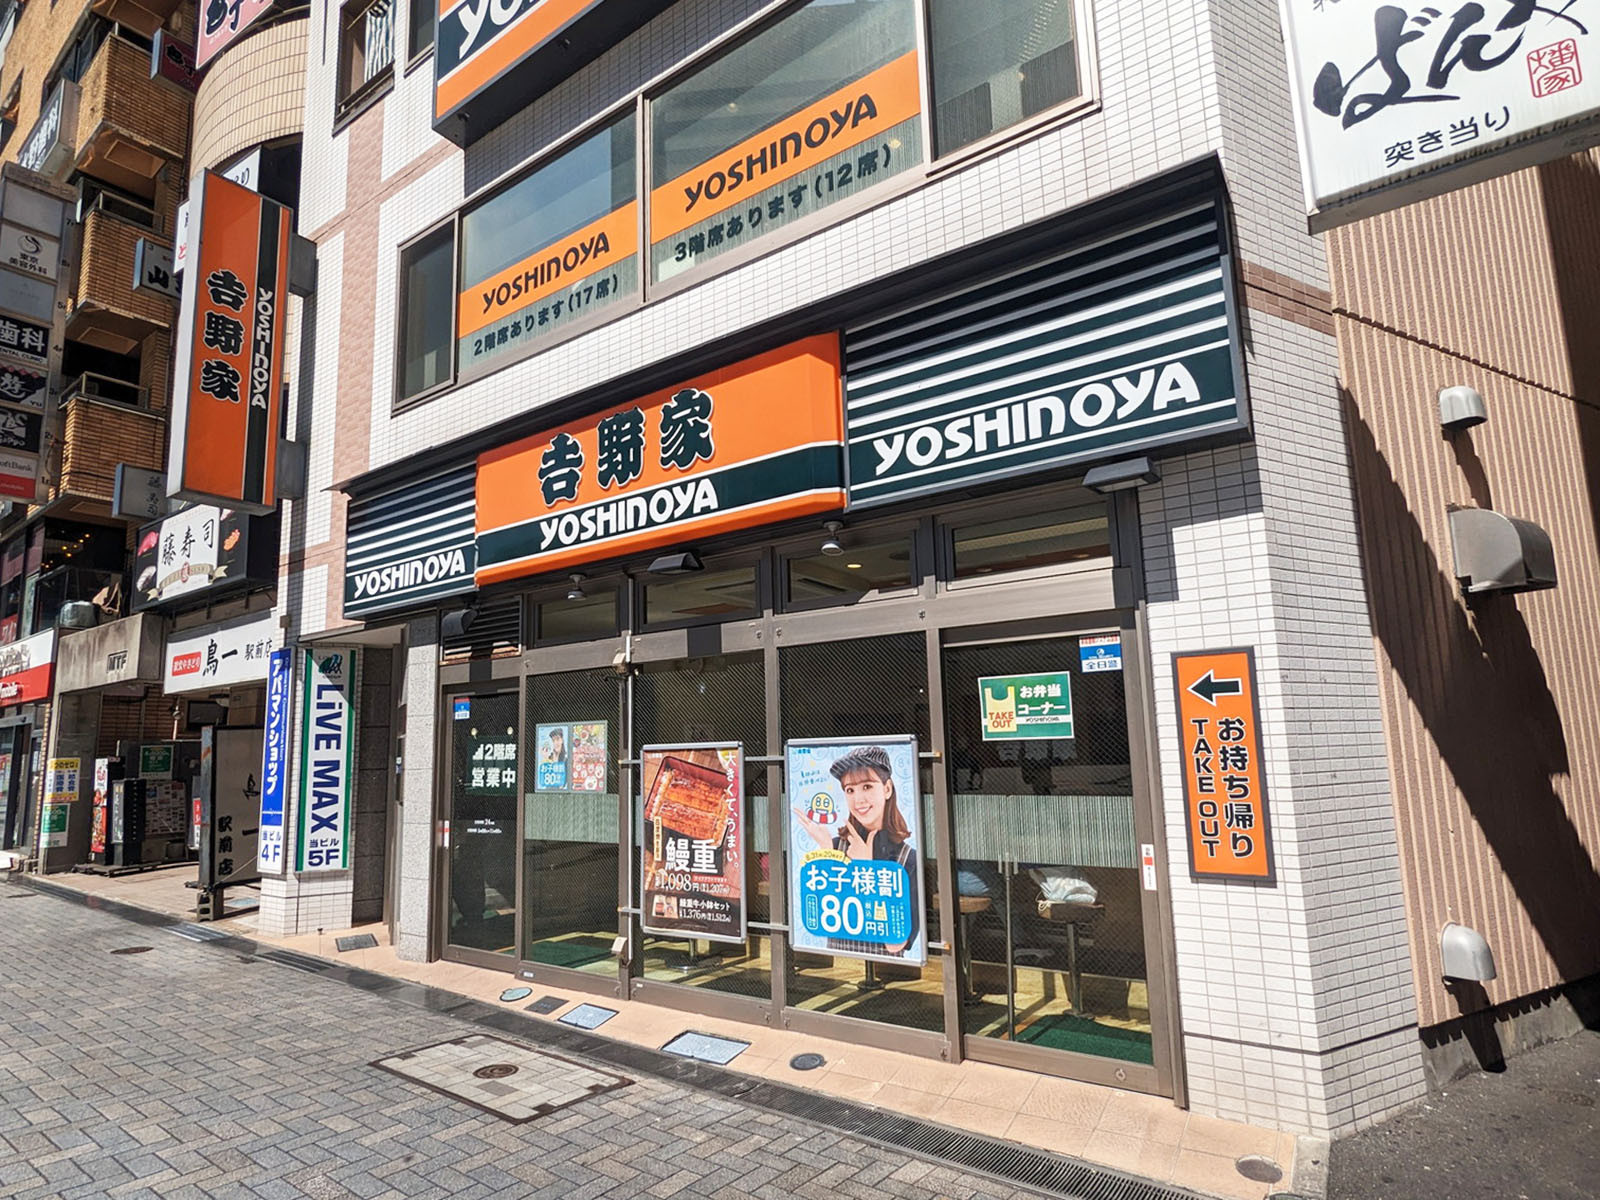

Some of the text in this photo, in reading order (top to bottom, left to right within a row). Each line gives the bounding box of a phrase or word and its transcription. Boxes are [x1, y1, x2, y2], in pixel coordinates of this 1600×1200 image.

[684, 93, 878, 213] YOSHINOYA
[1384, 106, 1511, 168] 突き当り
[674, 143, 892, 262] 3階席あります(12席)
[482, 231, 610, 315] YOSHINOYA
[473, 273, 618, 357] 2階席あります(17席)
[251, 287, 273, 410] YOSHINOYA
[873, 361, 1201, 477] YOSHINOYA
[0, 459, 33, 473] oftBank
[537, 388, 715, 508] 吉野家
[540, 478, 719, 551] YOSHINOYA
[354, 548, 466, 599] YOSHINOYA
[1017, 701, 1067, 715] コーナー
[1019, 683, 1062, 698] お弁当
[266, 658, 284, 796] アパマンショップ
[988, 711, 1014, 721] TAKE
[992, 719, 1013, 729] OUT
[484, 743, 517, 761] 2階席
[310, 759, 340, 834] MAX
[471, 767, 516, 788] 営業中
[1191, 718, 1220, 858] TAKE OUT
[1217, 717, 1254, 858] お持ち帰り
[261, 844, 281, 863] 4F
[308, 849, 340, 867] 5F
[309, 838, 340, 848] 当ビル
[665, 837, 718, 874] 鰻重
[805, 864, 903, 898] お子様割
[820, 894, 865, 936] 80
[865, 921, 889, 937] 円引
